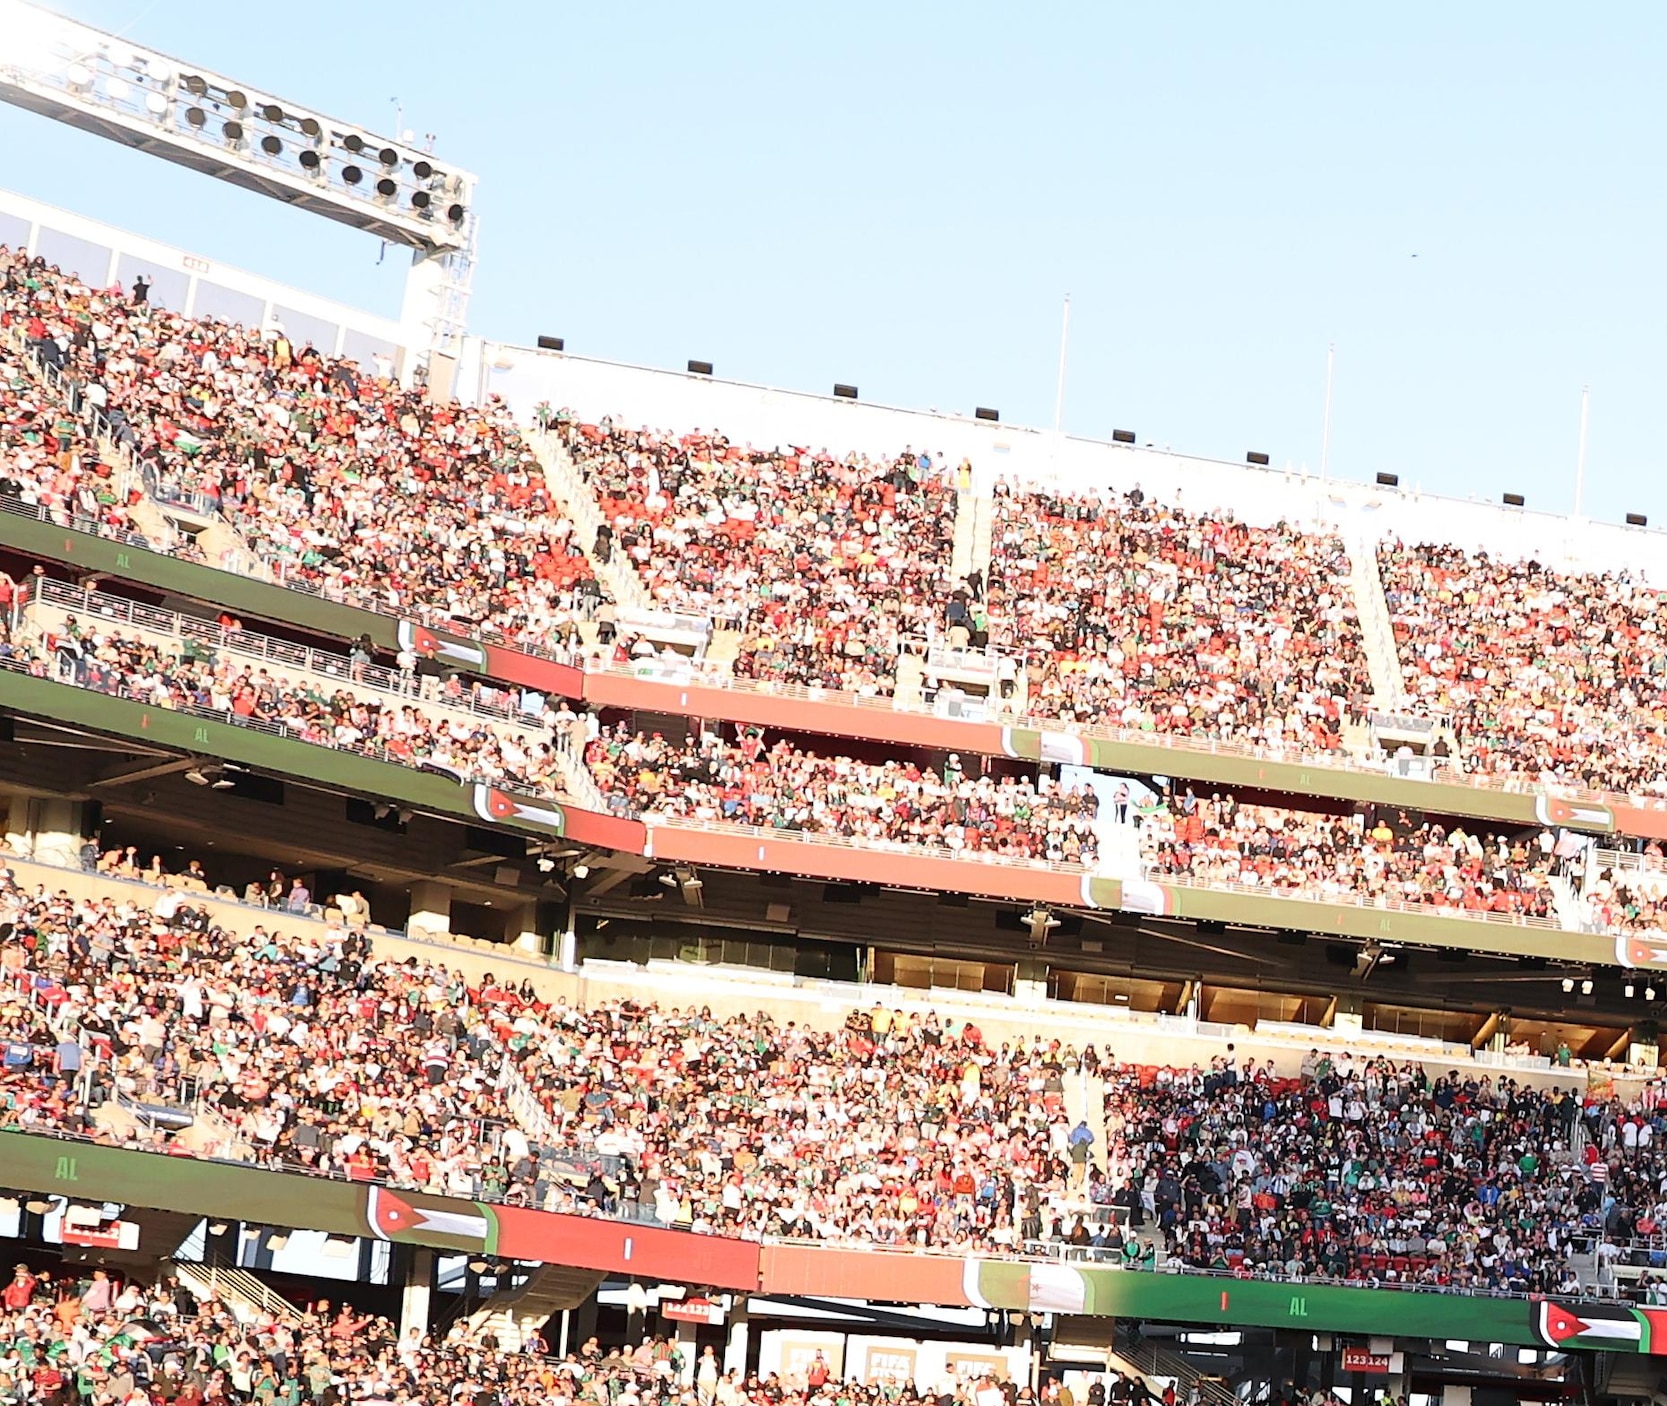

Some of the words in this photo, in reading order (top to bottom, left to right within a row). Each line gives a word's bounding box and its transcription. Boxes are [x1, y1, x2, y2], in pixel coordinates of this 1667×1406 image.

[56, 1157, 78, 1181] AL
[1290, 1297, 1307, 1317] AL
[1346, 1355, 1367, 1366] 123
[1368, 1357, 1388, 1368] 124
